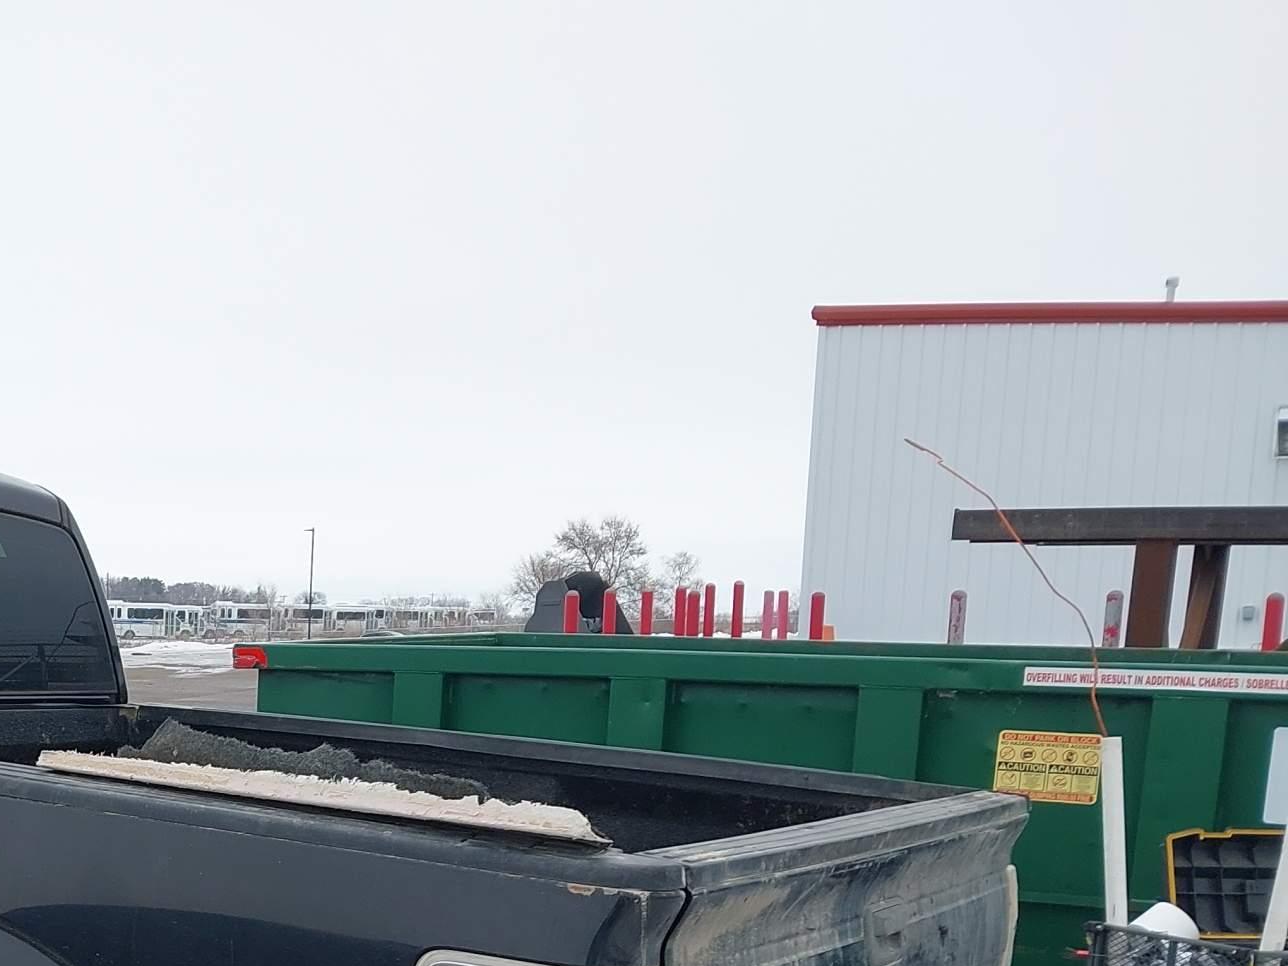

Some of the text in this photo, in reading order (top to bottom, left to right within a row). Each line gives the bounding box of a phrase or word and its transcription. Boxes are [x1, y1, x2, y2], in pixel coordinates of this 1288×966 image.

[1026, 672, 1078, 684] OVERFILLING
[1101, 674, 1132, 685] RESULT
[1134, 675, 1143, 685] IN
[1145, 675, 1195, 687] ADDITIONAL
[1198, 677, 1238, 688] CHARGES
[1007, 763, 1046, 772] CAUTION
[1058, 766, 1097, 775] CAUTION
